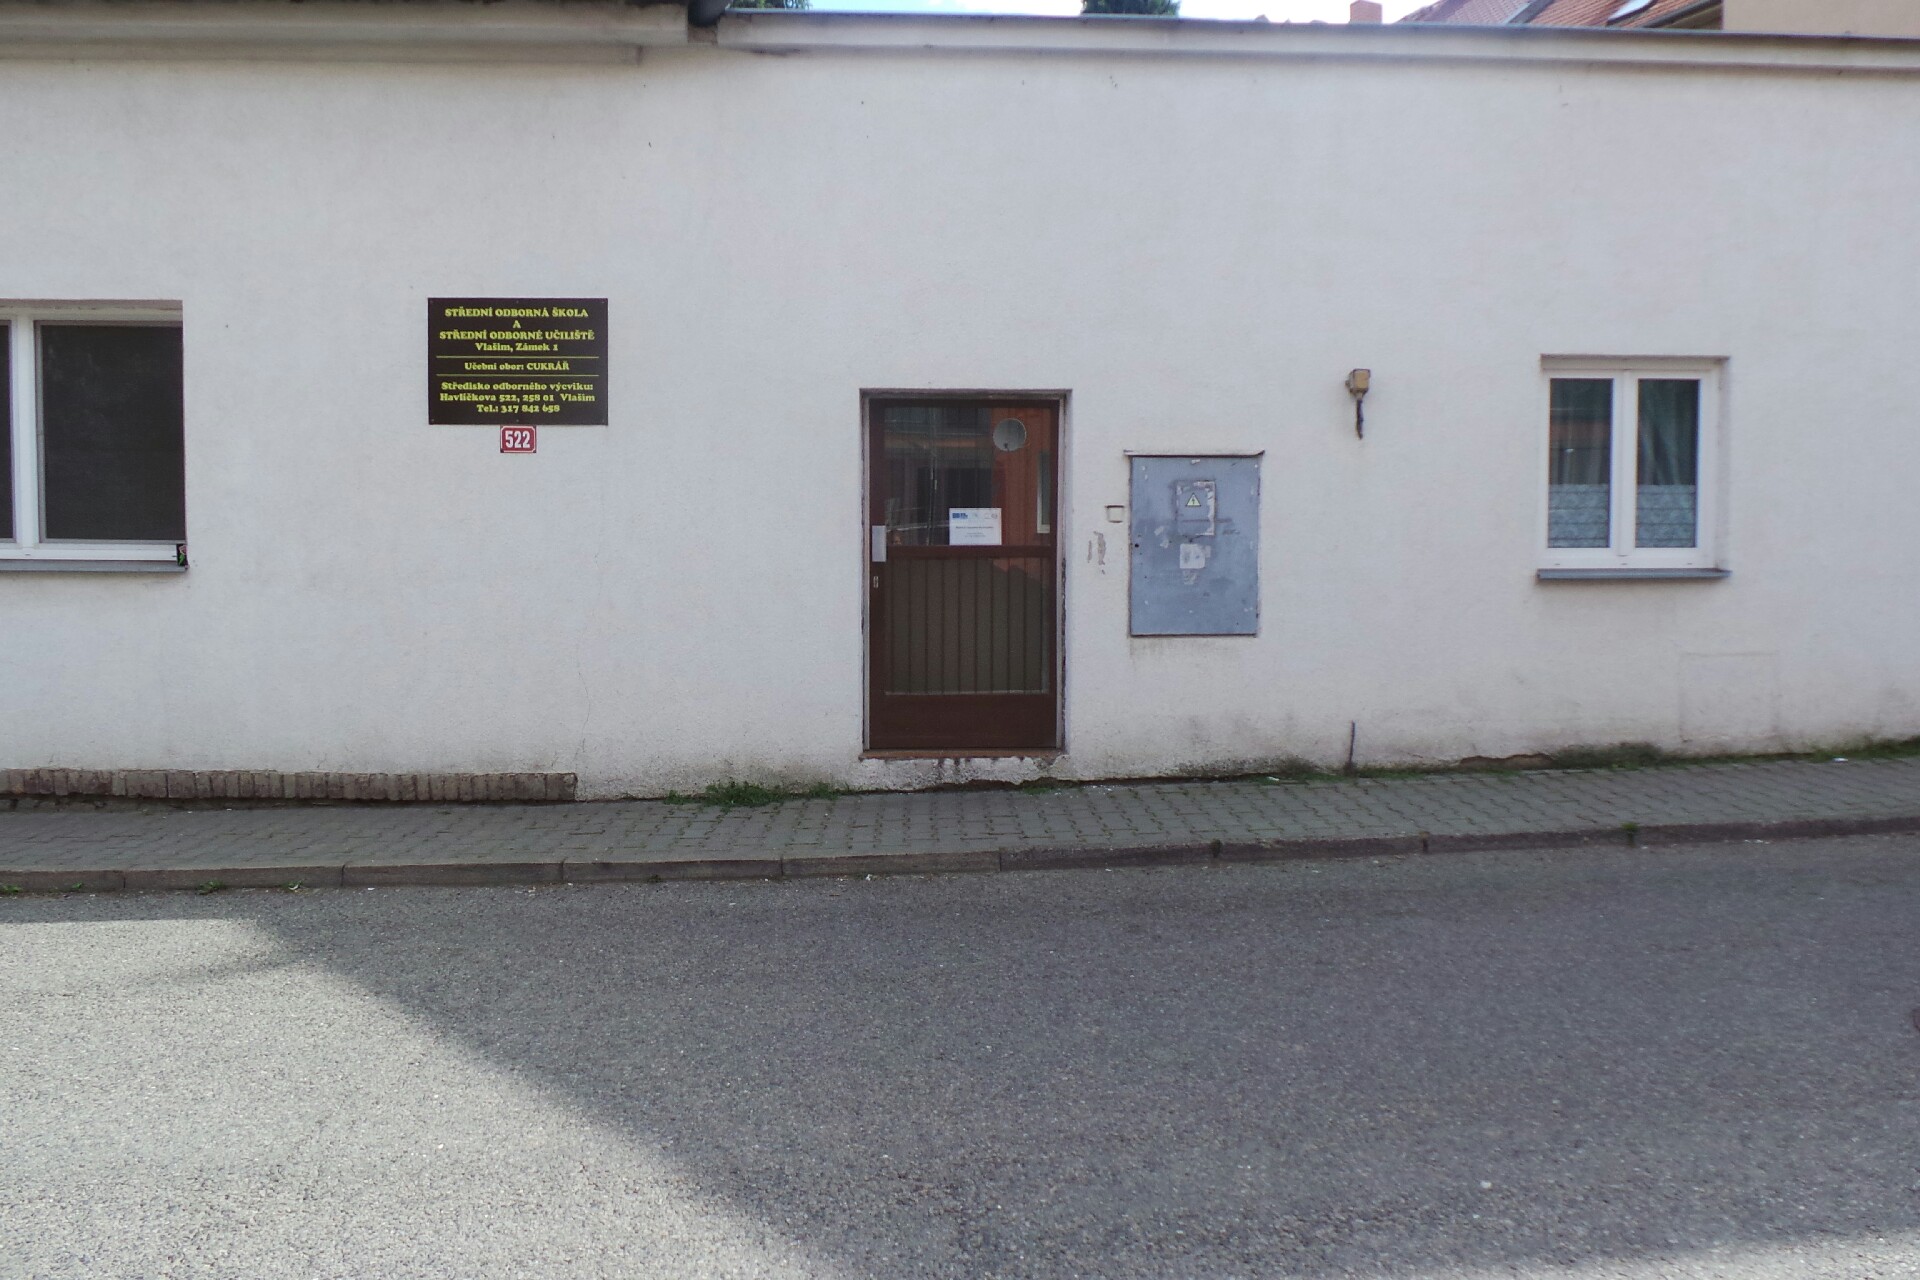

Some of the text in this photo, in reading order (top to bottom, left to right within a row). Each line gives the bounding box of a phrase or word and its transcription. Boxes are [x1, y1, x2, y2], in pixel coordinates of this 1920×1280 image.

[445, 306, 588, 317] STŘEDNÍ ODBORNÁ ŠKOLA
[513, 320, 521, 329] A
[440, 329, 595, 340] STŘEDNÍ ODBORNÉ UČILIŠTĚ
[475, 342, 513, 352] Vlašim,
[515, 342, 550, 351] Zámek
[499, 362, 524, 371] obor:
[526, 360, 570, 371] CUKRÁŘ
[441, 381, 593, 391] Středisko odborného výcviku:
[440, 392, 496, 401] Havlíčkova
[499, 394, 520, 402] 522,
[522, 394, 541, 402] 258
[560, 393, 595, 401] Vlašim
[476, 402, 560, 413] Tel.: 317 842 658
[505, 430, 530, 448] 522
